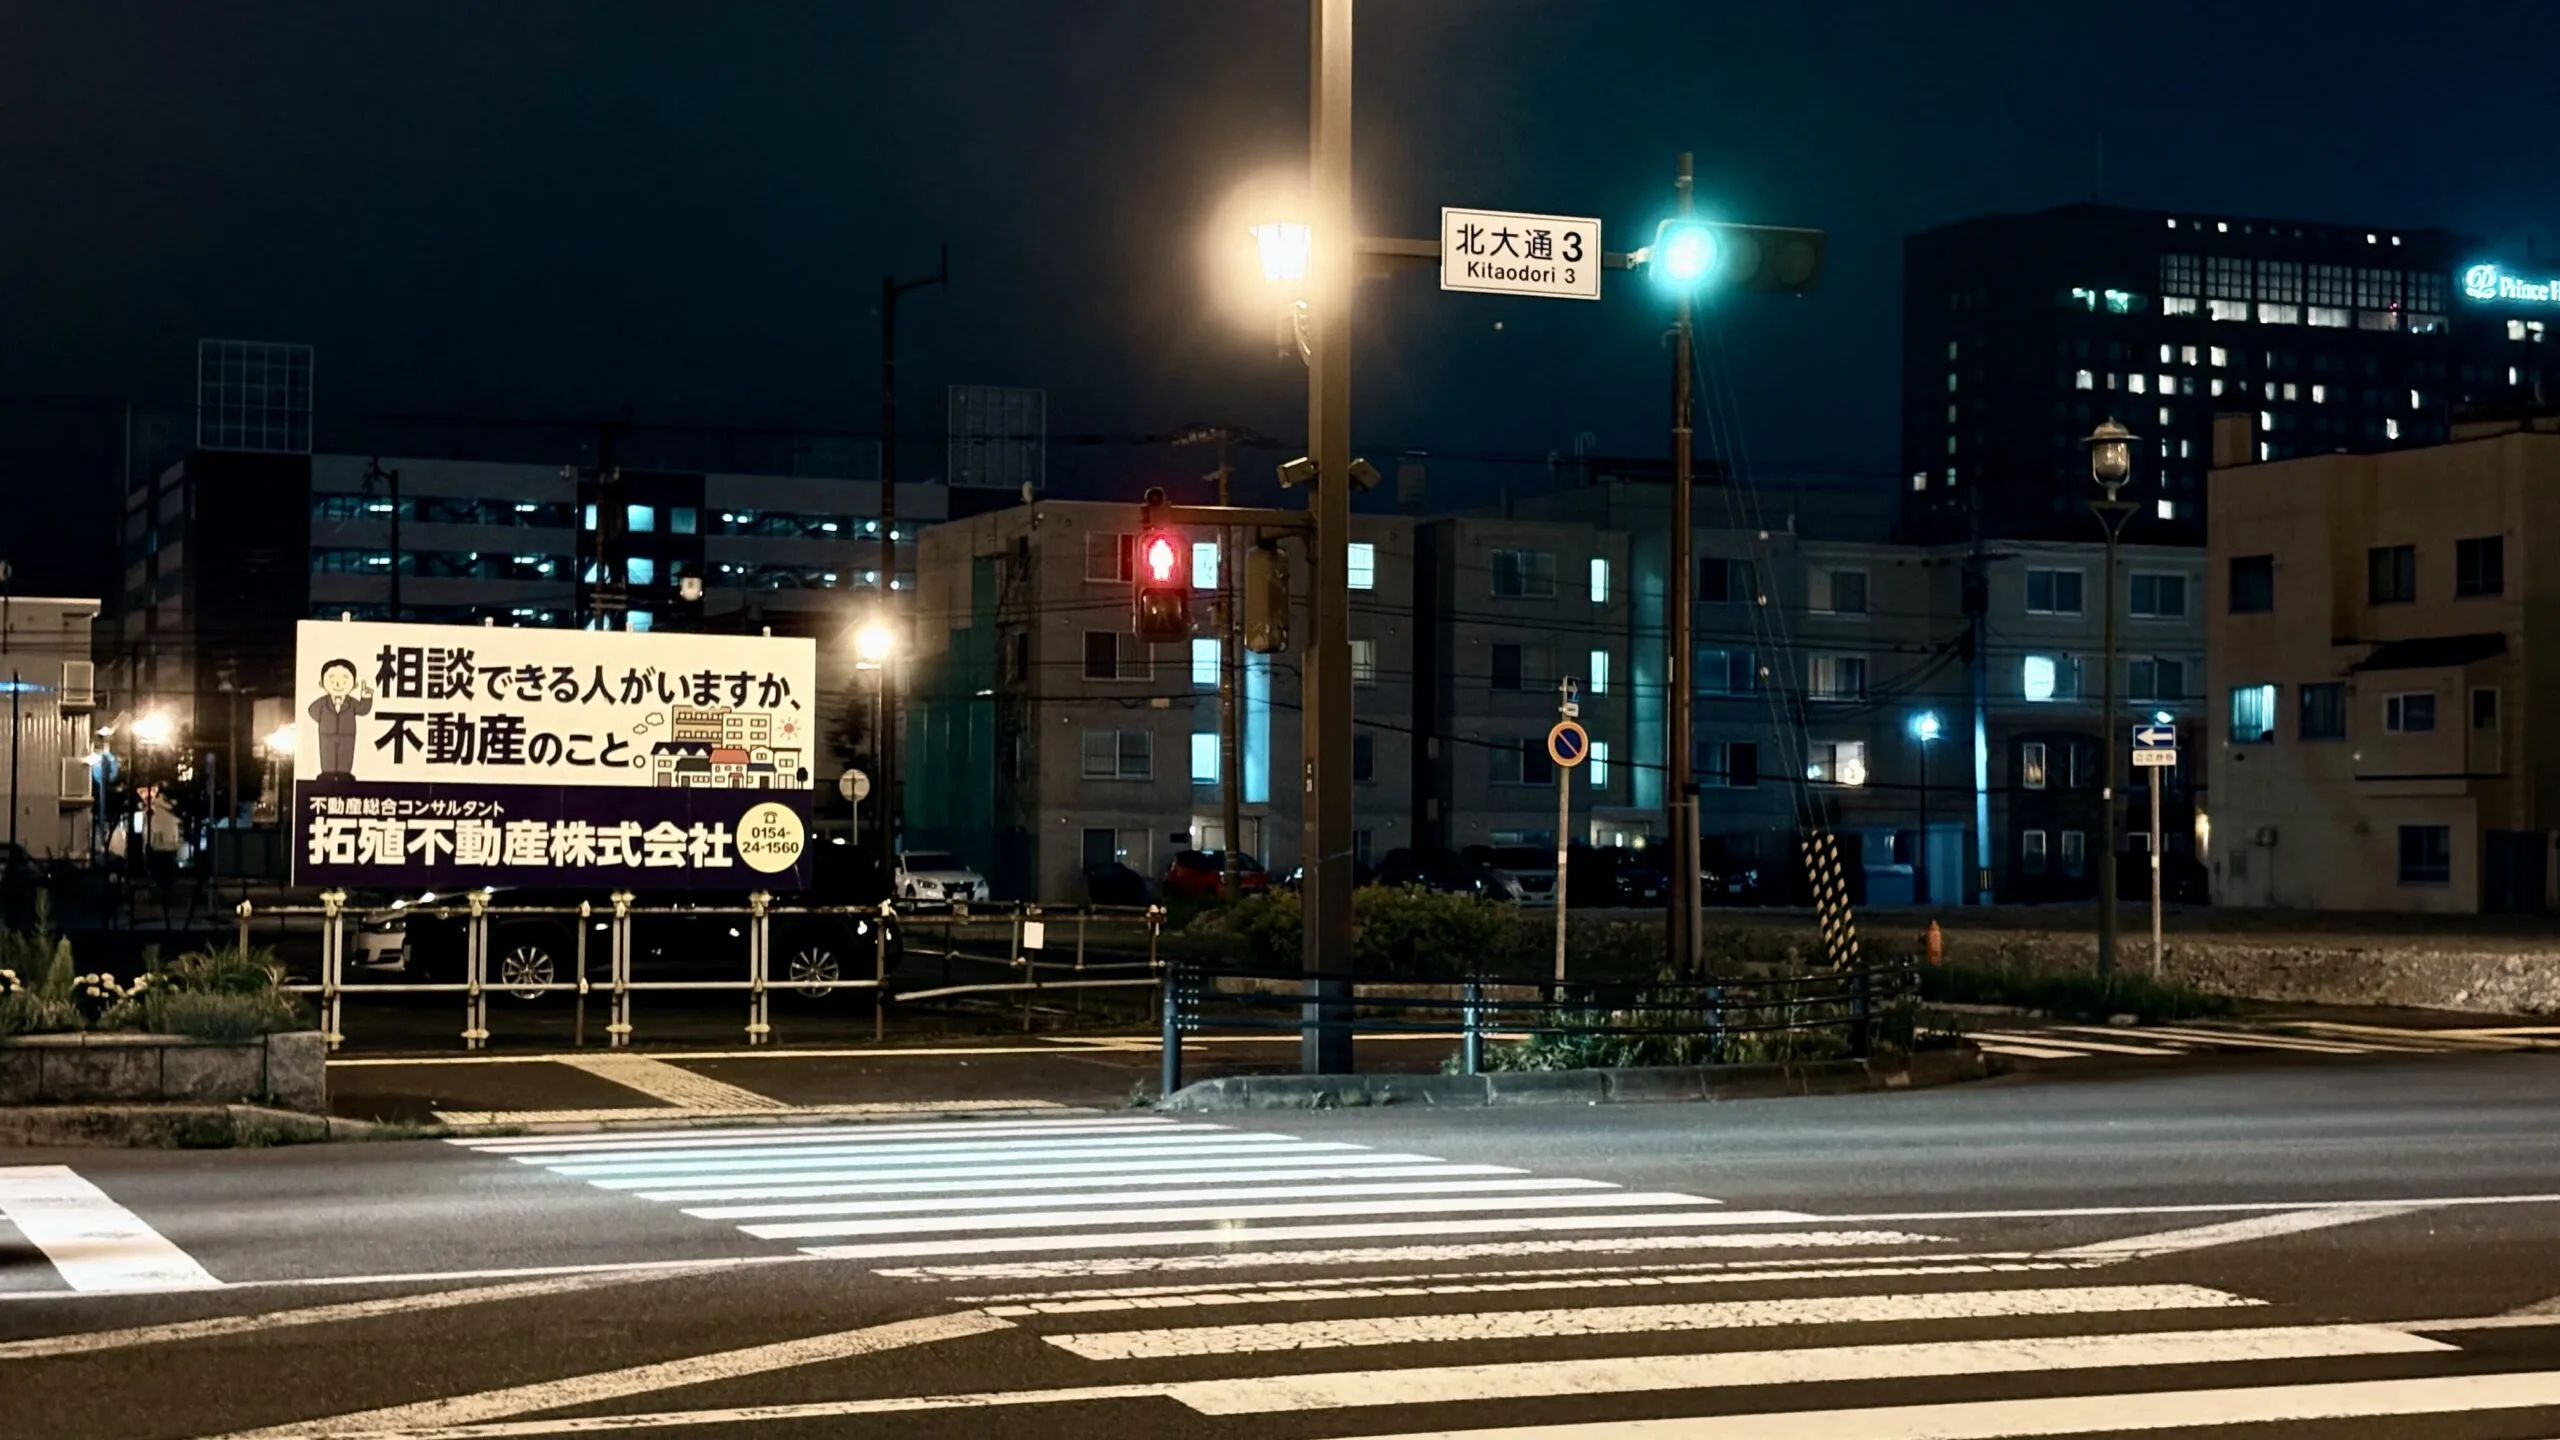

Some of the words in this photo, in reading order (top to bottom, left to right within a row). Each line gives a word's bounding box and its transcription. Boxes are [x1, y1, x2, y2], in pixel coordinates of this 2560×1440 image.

[1456, 223, 1553, 261] 北大通
[1562, 231, 1583, 262] 3
[1467, 260, 1555, 283] Kitaodori
[1564, 268, 1576, 284] 3
[2499, 276, 2550, 301] Prince
[375, 645, 802, 709] 相談できる人がいますか、
[374, 711, 646, 769] 不動産のこと。
[309, 797, 505, 817] 不動産総合コンサルタント
[308, 817, 733, 868] 拓殖不動産株式会社
[751, 827, 792, 839] 0154-
[742, 841, 799, 854] 24-1560
